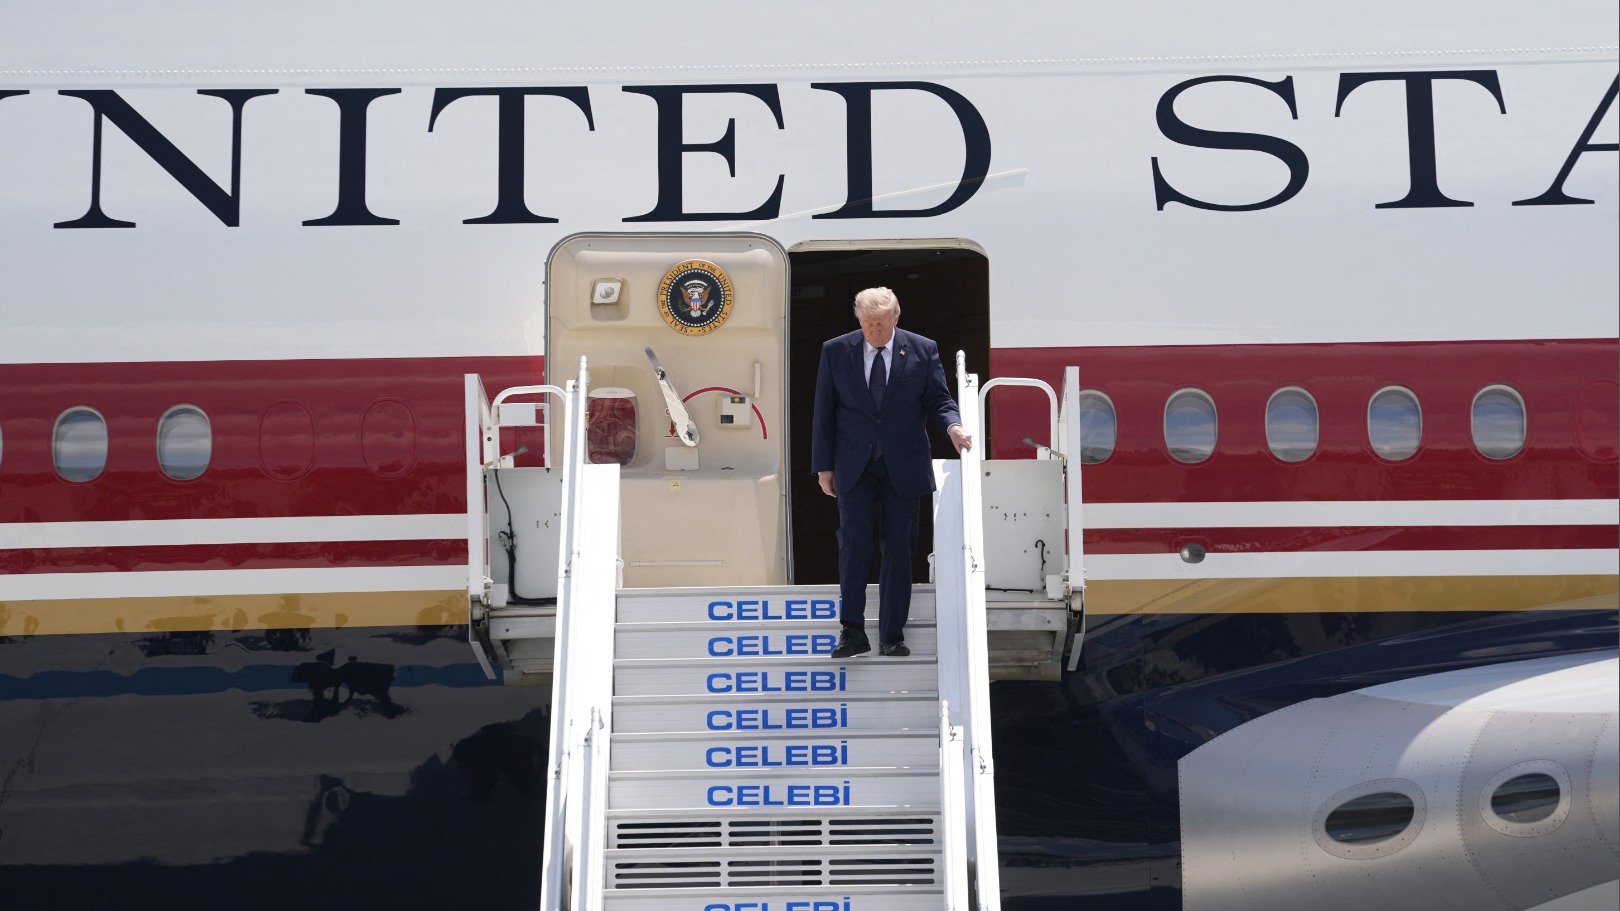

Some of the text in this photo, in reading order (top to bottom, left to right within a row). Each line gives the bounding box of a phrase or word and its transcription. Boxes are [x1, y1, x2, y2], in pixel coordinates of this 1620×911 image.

[0, 80, 991, 229] NITED
[660, 263, 693, 296] PRESIDENT
[718, 273, 731, 306] UNITED
[670, 318, 688, 333] SEAL
[702, 311, 728, 333] STATES
[707, 630, 842, 657] CELEB
[706, 667, 847, 693] CELEBİ
[706, 703, 848, 731] CELEBİ
[705, 740, 848, 767] CELEBİ
[706, 781, 850, 806] CELEBİ
